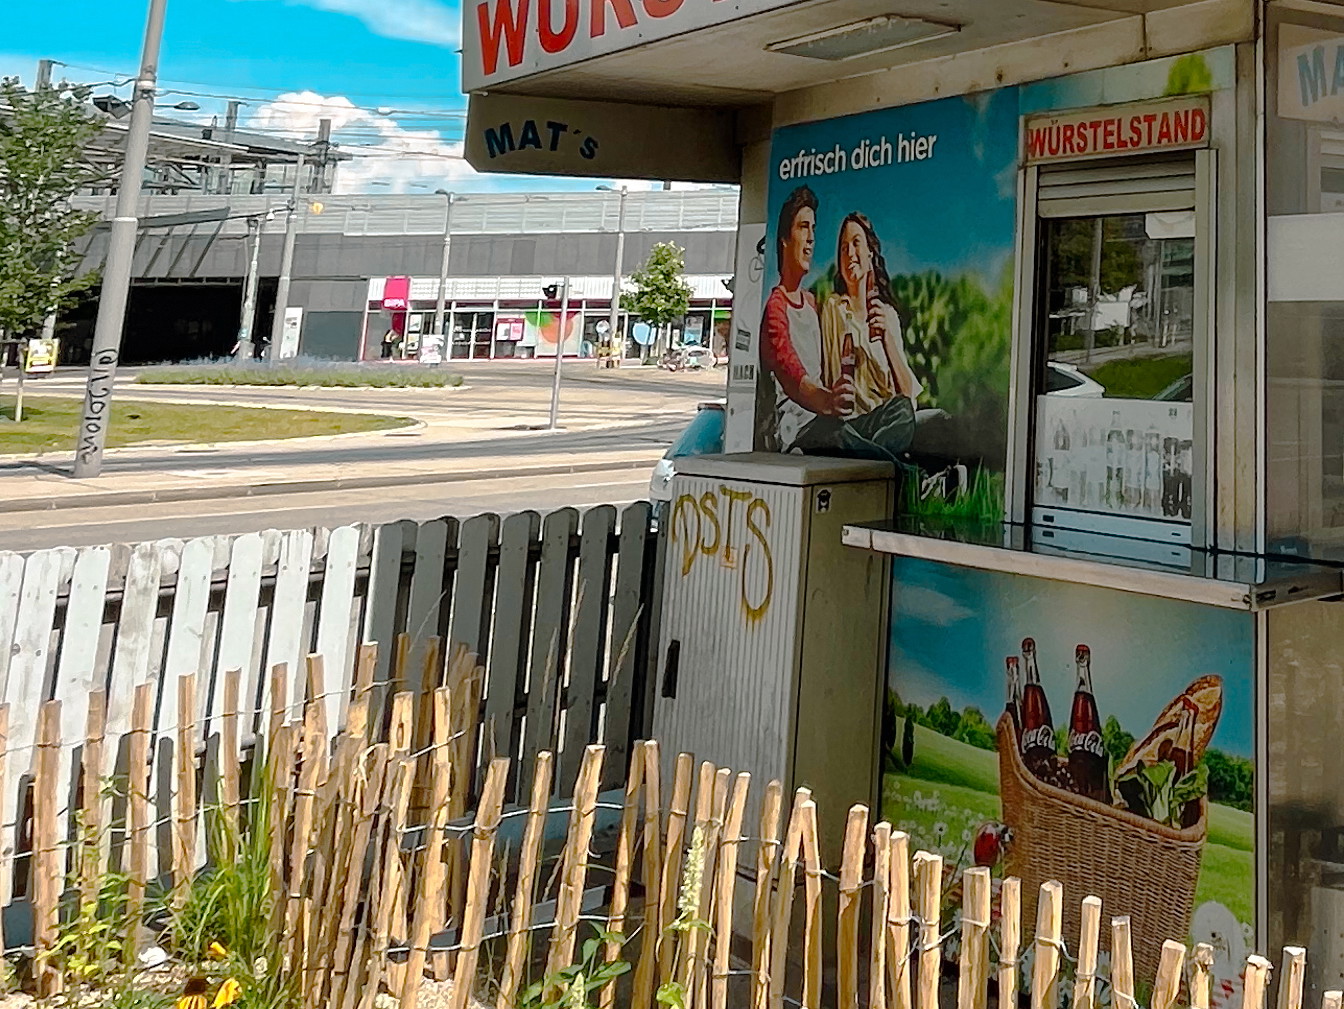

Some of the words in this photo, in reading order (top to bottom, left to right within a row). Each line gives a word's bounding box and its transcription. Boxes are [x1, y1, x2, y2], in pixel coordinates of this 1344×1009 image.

[779, 143, 847, 180] erfrisch
[850, 135, 893, 170] dich
[897, 131, 937, 163] hier
[1027, 108, 1206, 158] WÜRSTELSTAND
